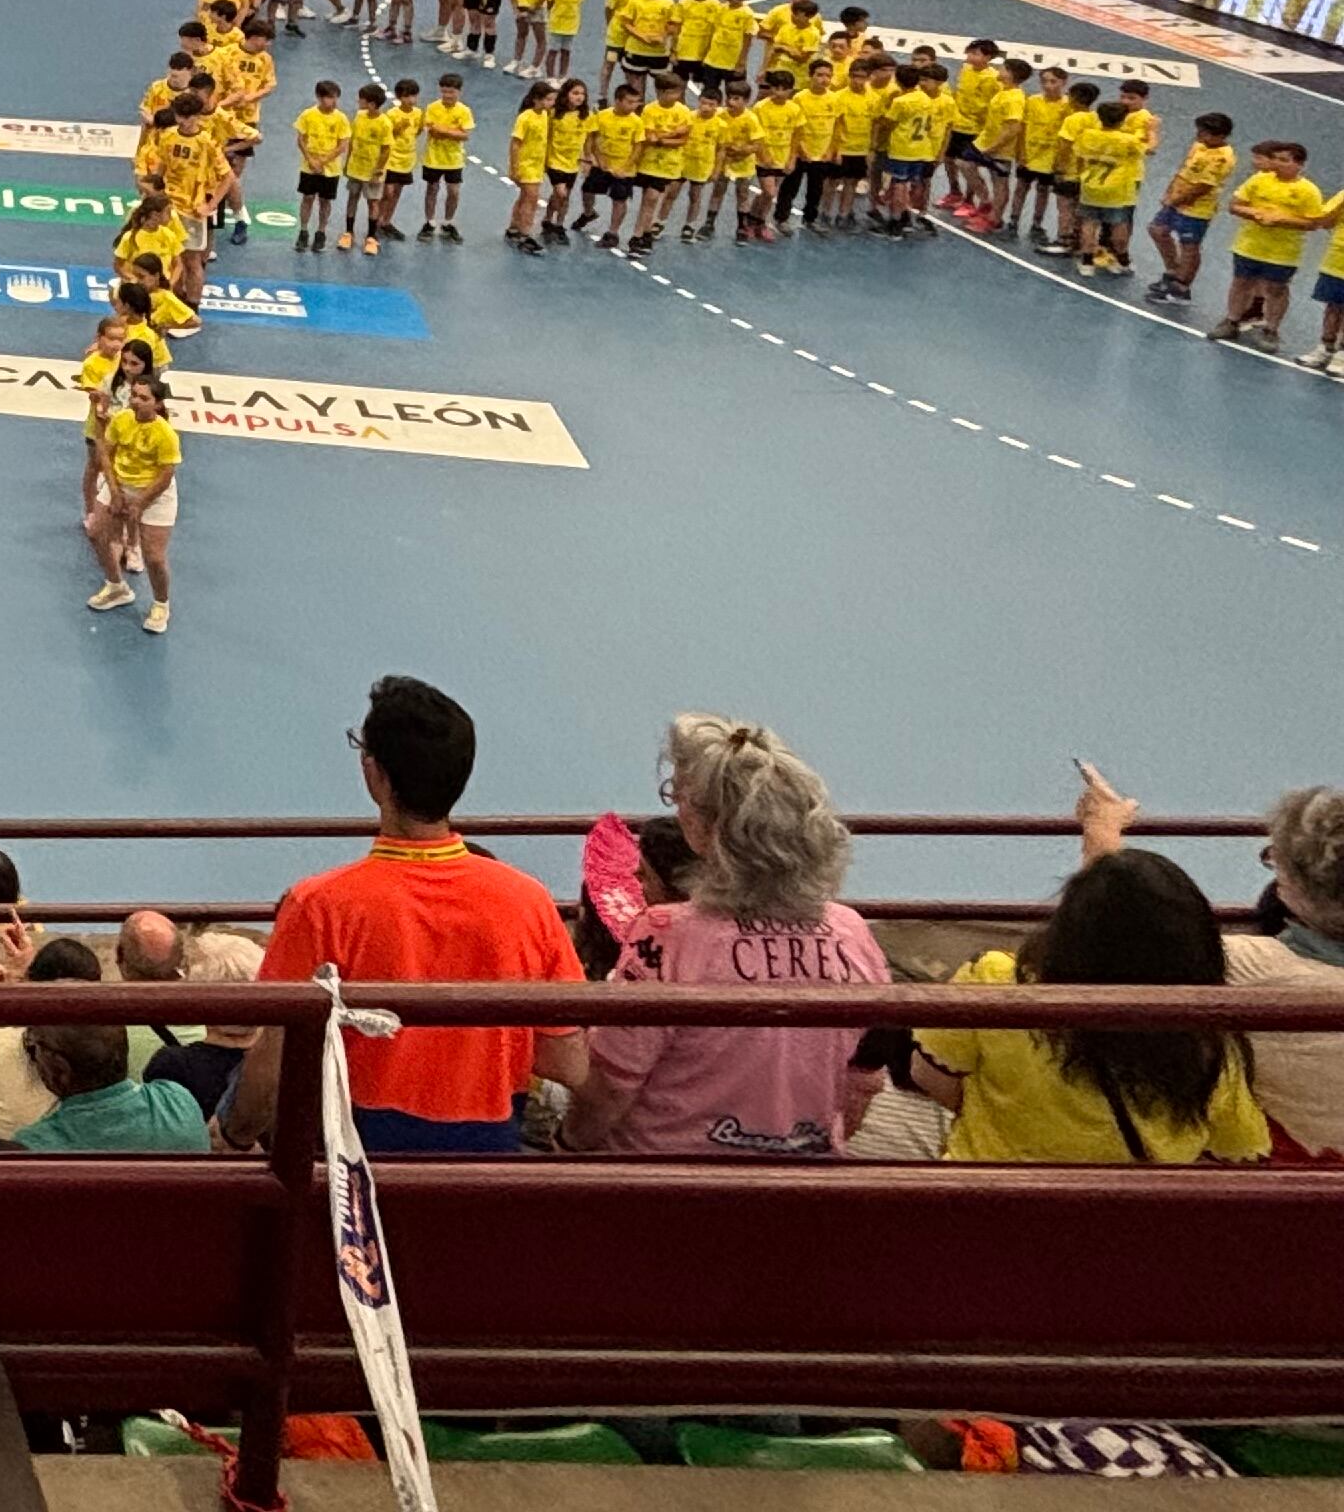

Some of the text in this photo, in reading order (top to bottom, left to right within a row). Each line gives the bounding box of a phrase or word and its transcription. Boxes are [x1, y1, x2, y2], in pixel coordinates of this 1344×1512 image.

[1088, 158, 1113, 185] 77
[191, 410, 391, 441] IMPULSA
[295, 393, 533, 433] Y LEÓN
[731, 937, 853, 982] CERES
